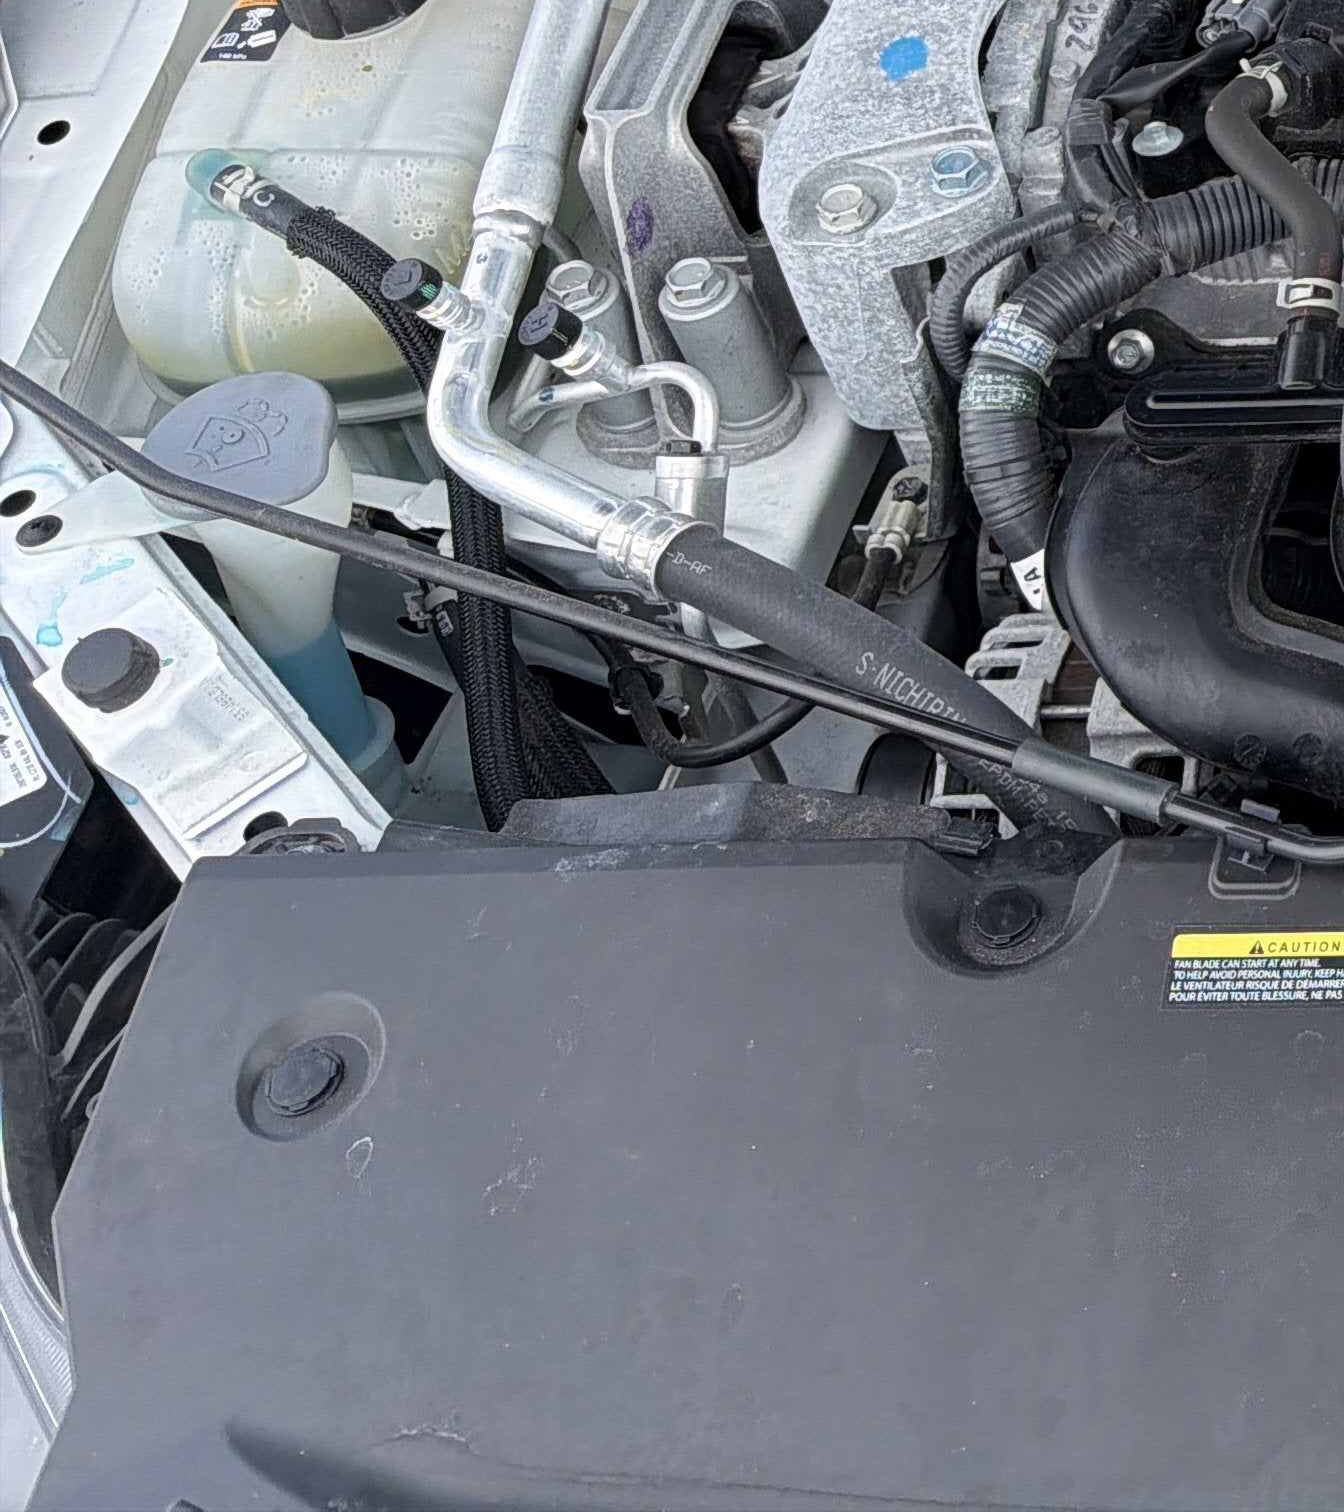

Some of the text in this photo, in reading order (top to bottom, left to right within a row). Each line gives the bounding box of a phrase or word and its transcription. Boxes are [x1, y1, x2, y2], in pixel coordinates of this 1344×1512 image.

[1267, 941, 1341, 954] CAUTION
[1174, 960, 1192, 969] FAN
[1192, 960, 1220, 968] BLADE
[1221, 960, 1240, 968] CAN
[1241, 959, 1266, 968] START
[1267, 959, 1278, 968] AT
[1278, 959, 1298, 967] ANY
[1173, 971, 1185, 979] TO
[1186, 971, 1207, 979] HELP
[1209, 970, 1236, 979] AVOID
[1237, 970, 1281, 979] PERSONAL
[1314, 969, 1336, 977] KEEP
[1171, 982, 1182, 990] LE
[1183, 981, 1244, 989] VENTILATEUR
[1245, 981, 1280, 989] RISQUE
[1281, 981, 1294, 989] DE
[1169, 993, 1196, 1001] POUR
[1197, 991, 1229, 1001] ÉVITER
[1230, 992, 1260, 1001] TOUTE
[1311, 991, 1323, 999] NE
[1325, 991, 1344, 999] PAS
